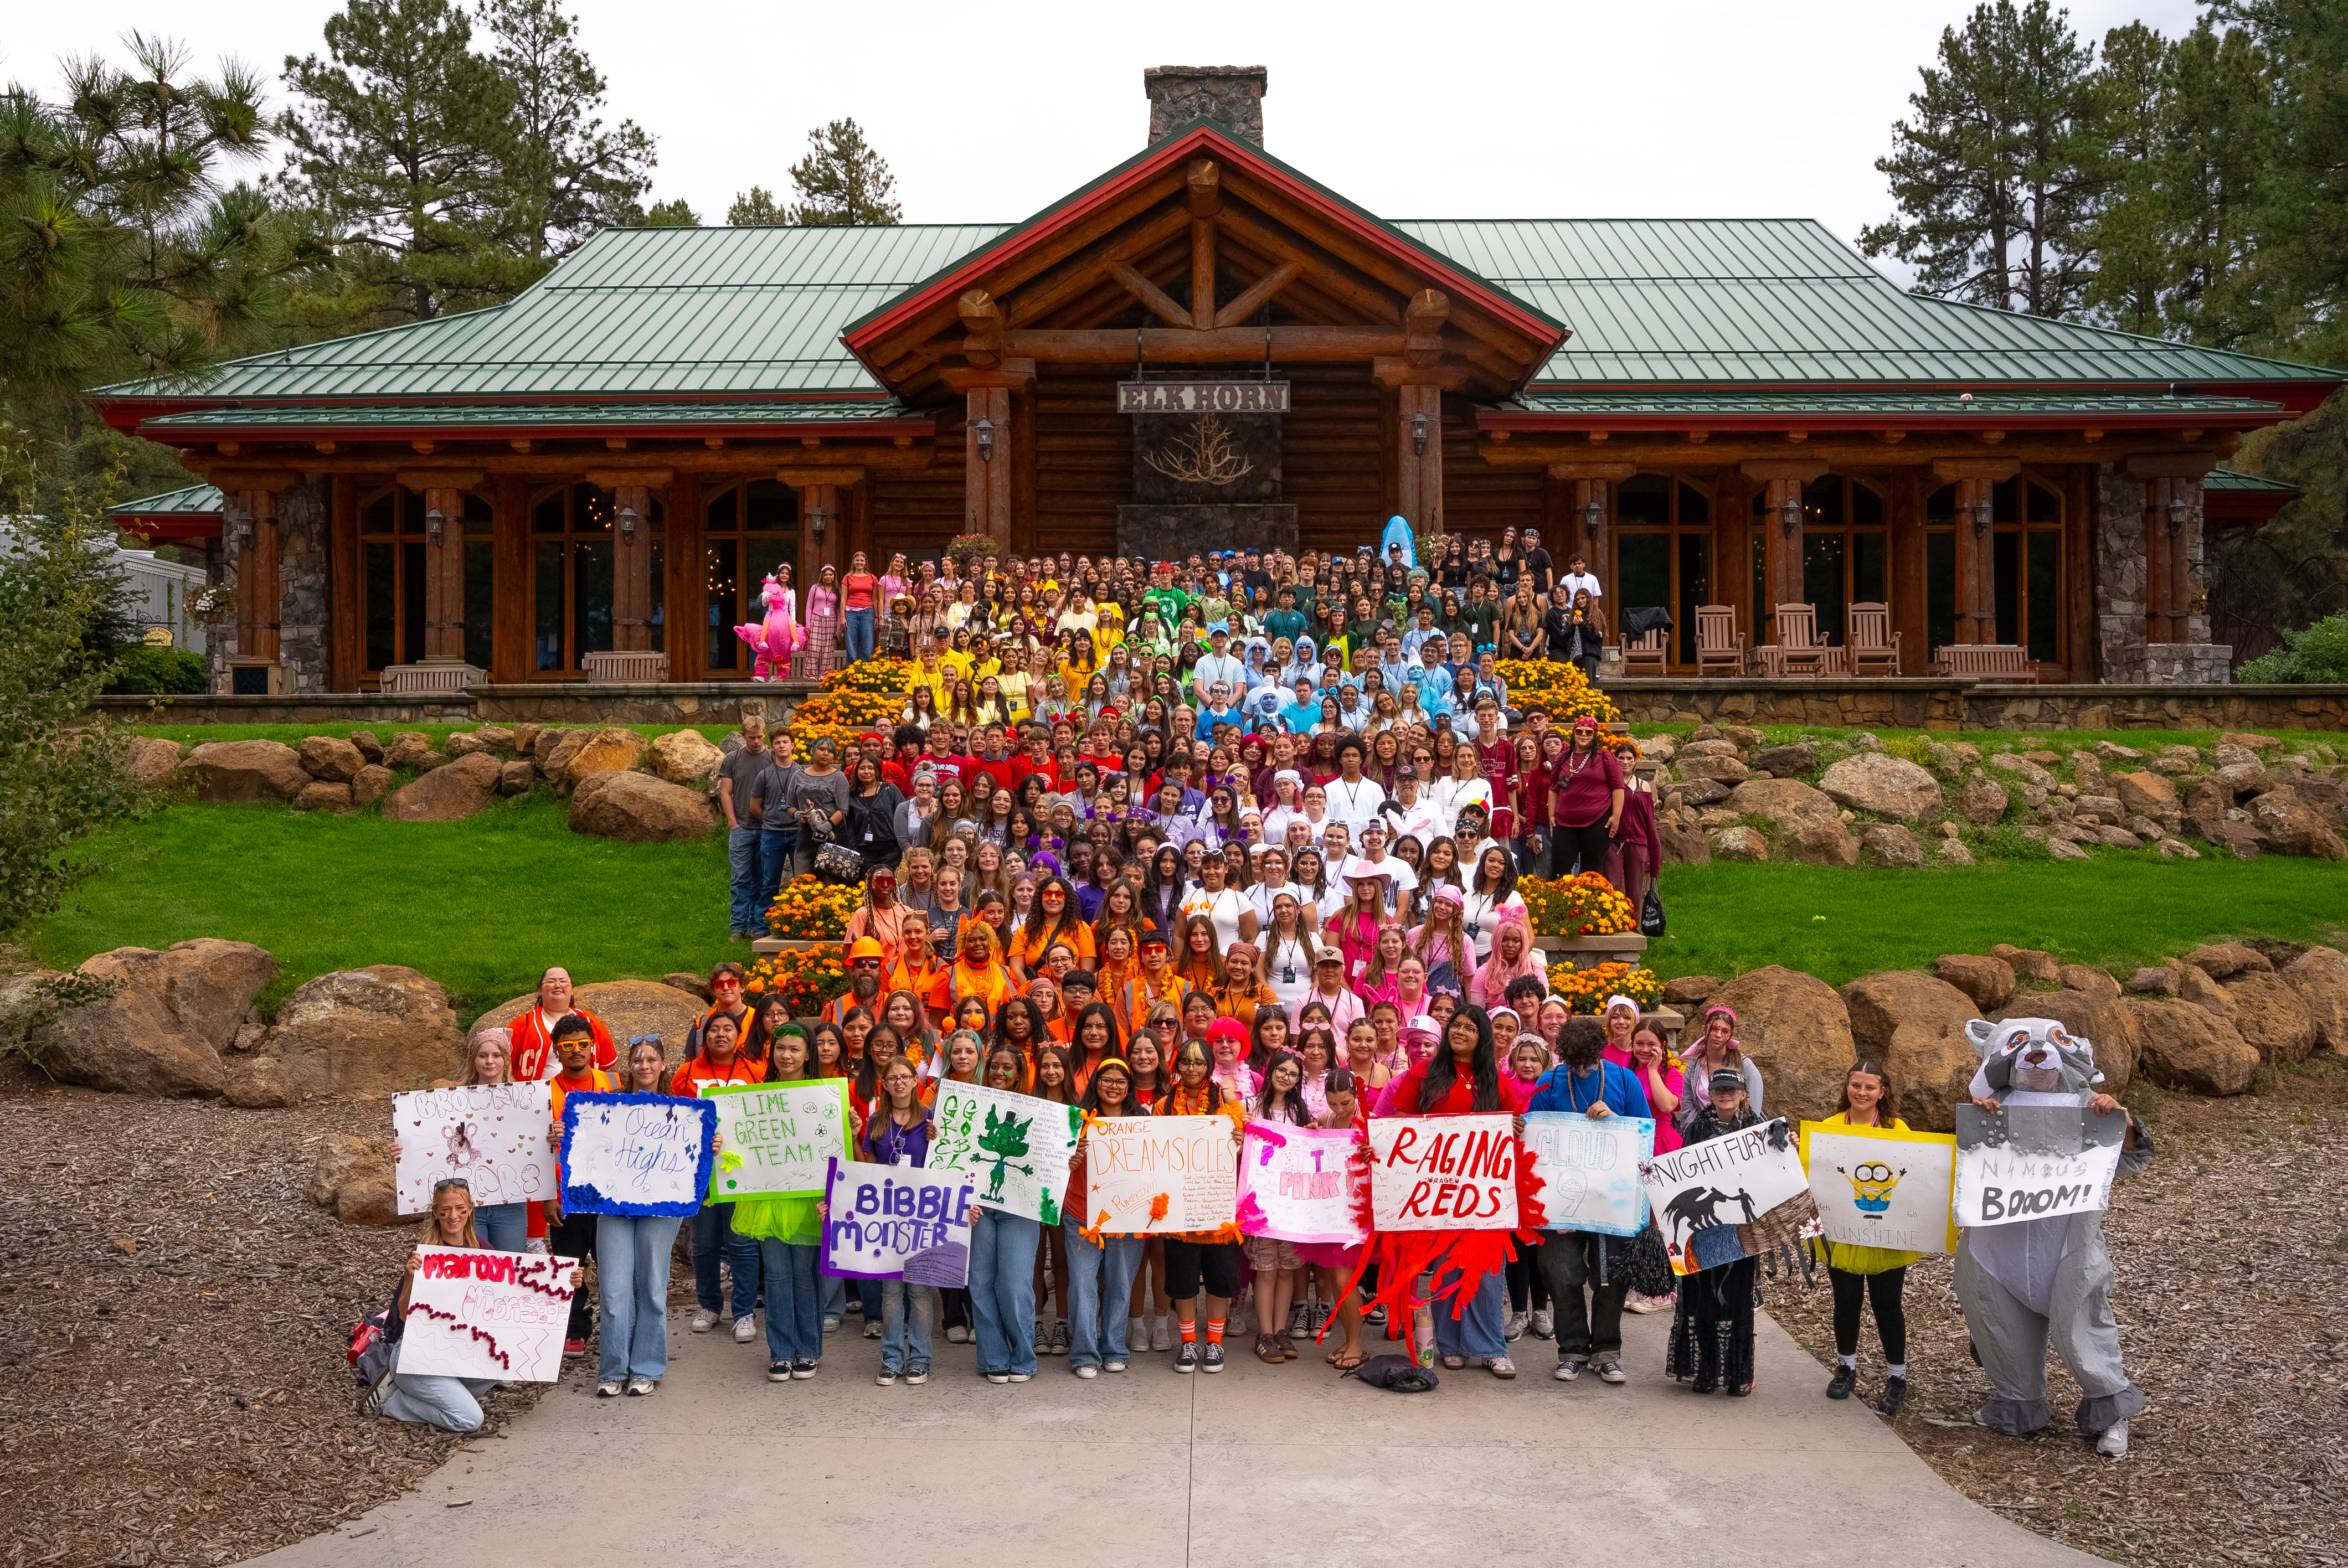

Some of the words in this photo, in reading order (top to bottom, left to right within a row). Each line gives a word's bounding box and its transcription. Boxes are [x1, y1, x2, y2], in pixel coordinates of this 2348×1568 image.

[1124, 385, 1185, 410] ELK
[1193, 385, 1284, 410] HORN
[415, 1084, 536, 1119] BROWNIE
[742, 1092, 791, 1117] LIME
[1037, 1110, 1057, 1118] Tabitha
[625, 1108, 690, 1143] Ocean
[734, 1117, 796, 1144] GREEN
[1097, 1120, 1152, 1136] ORANGE
[615, 1137, 686, 1188] Highs
[748, 1143, 813, 1166] TEAM
[1092, 1137, 1235, 1175] DREAMSICLES
[1260, 1145, 1338, 1173] PRETTY
[1386, 1126, 1515, 1181] RAGING
[1535, 1129, 1618, 1171] CLOUD
[1654, 1143, 1723, 1187] NIGHT
[1724, 1127, 1768, 1165] FURY
[1980, 1156, 2087, 1184] NIMBUS
[1397, 1180, 1502, 1221] REDS
[1556, 1168, 1588, 1218] 9
[1823, 1221, 1921, 1246] SUNSHINE
